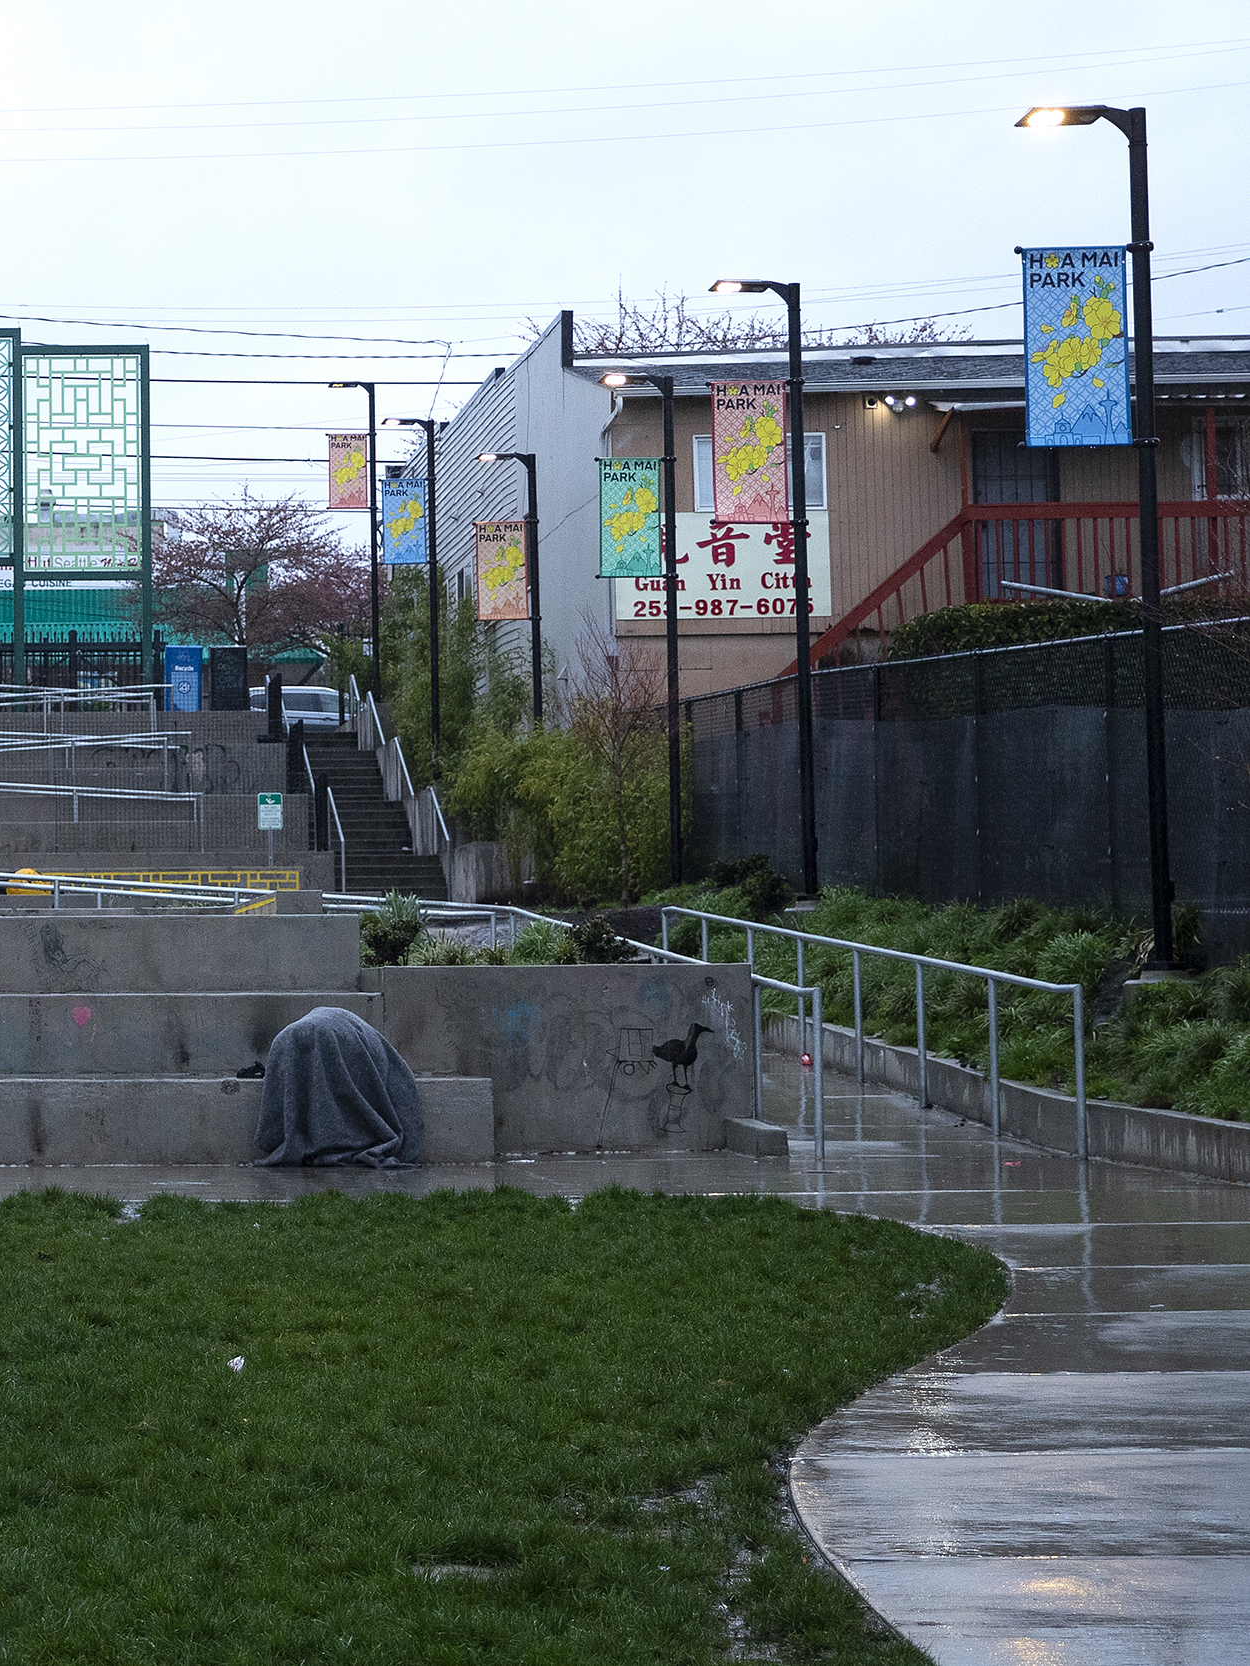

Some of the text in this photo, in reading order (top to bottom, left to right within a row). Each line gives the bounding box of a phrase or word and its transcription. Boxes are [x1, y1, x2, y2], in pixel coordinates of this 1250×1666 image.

[1081, 252, 1118, 268] MAI
[1030, 271, 1085, 288] PARK
[753, 384, 780, 396] MAI
[716, 398, 757, 410] PARK
[634, 461, 656, 470] MAI
[603, 472, 637, 482] PARK
[384, 489, 409, 497] PARK
[504, 524, 523, 532] MAI
[479, 533, 507, 542] PARK
[54, 557, 98, 568] Seatte
[706, 573, 741, 590] Yin
[175, 665, 195, 673] Recycle
